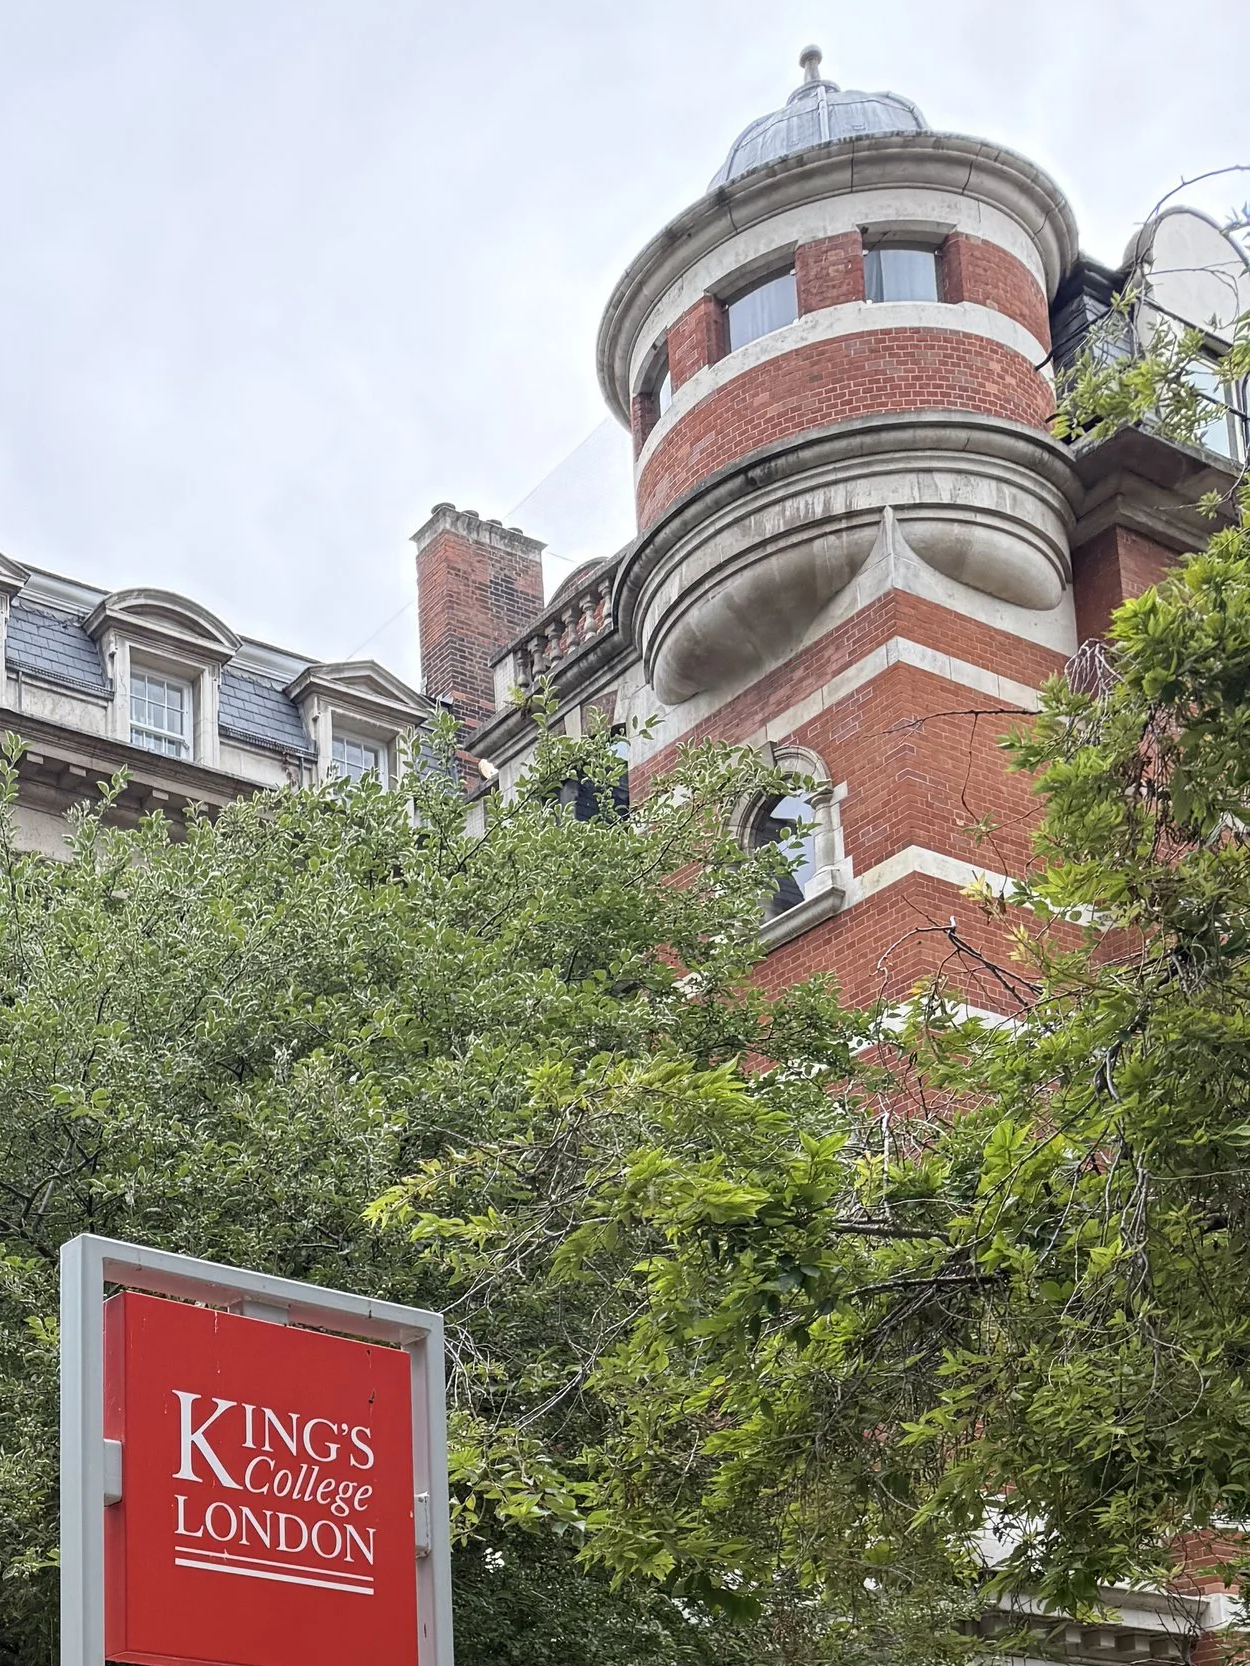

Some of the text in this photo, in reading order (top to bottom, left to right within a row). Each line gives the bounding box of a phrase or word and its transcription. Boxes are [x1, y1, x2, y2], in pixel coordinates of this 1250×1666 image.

[172, 1390, 374, 1490] KING'S
[244, 1456, 372, 1517] College
[174, 1495, 376, 1565] LONDON
